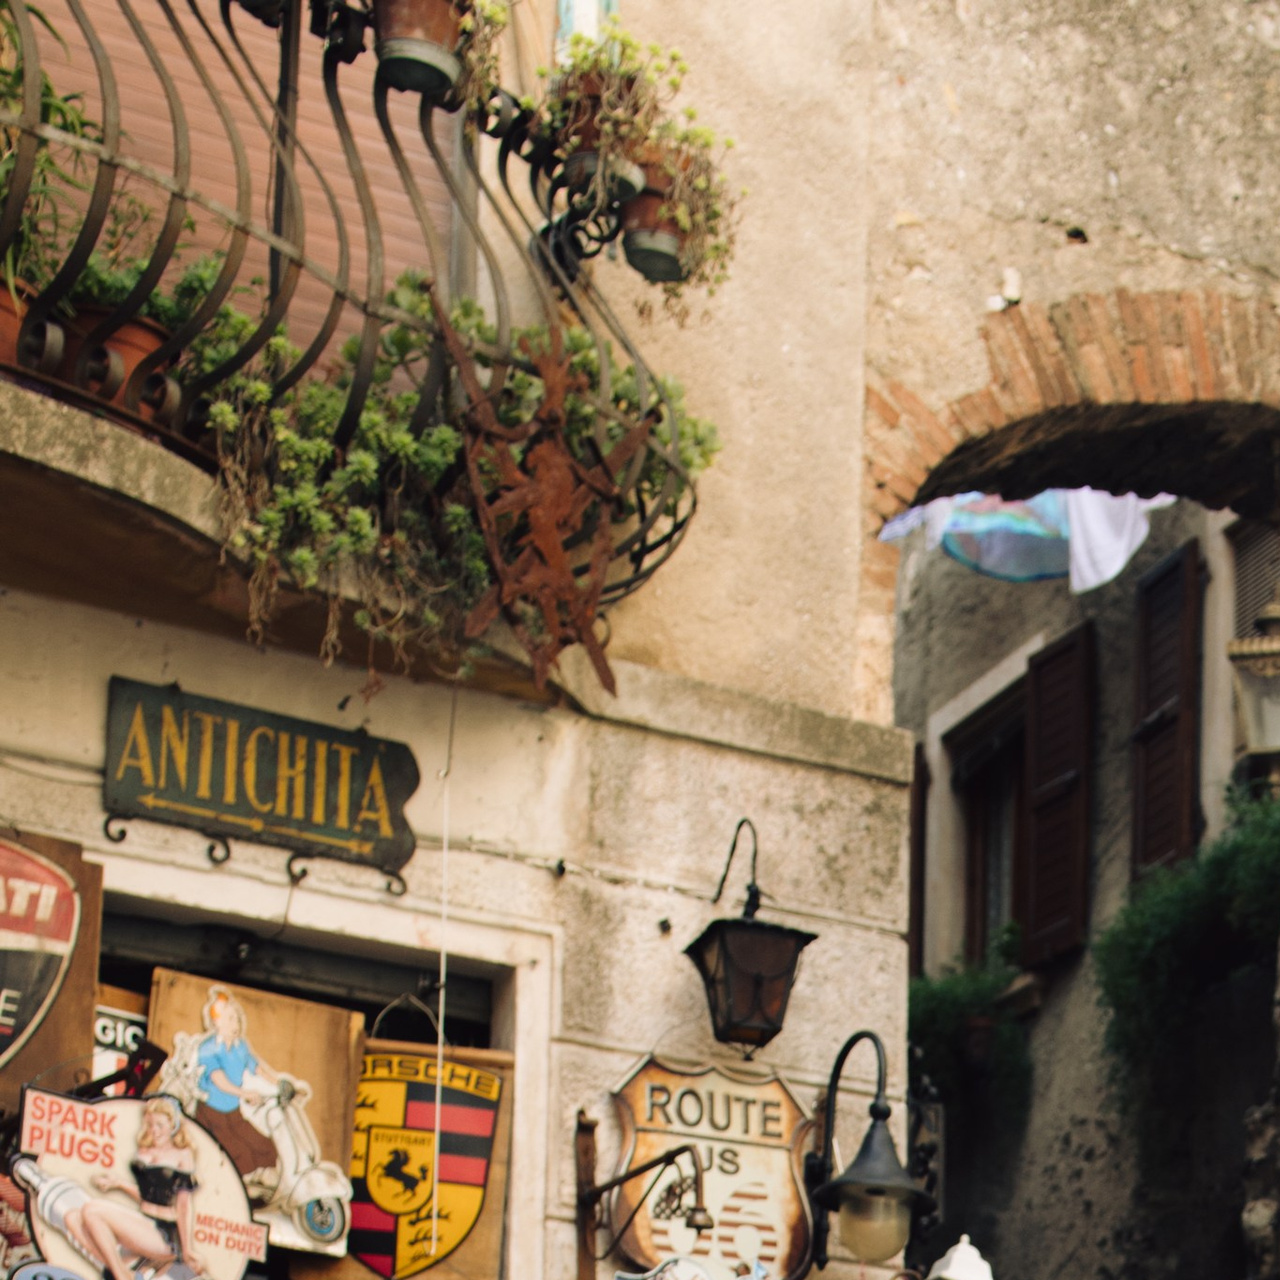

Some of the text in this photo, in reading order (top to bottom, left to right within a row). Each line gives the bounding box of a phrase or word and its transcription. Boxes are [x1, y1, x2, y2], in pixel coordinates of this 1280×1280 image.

[0, 876, 58, 923] TI
[30, 1095, 117, 1139] SPARK
[645, 1082, 783, 1138] ROUTE
[28, 1125, 116, 1169] PLUGS
[194, 1229, 263, 1257] ON DUTY
[195, 1213, 264, 1241] MECHANIC
